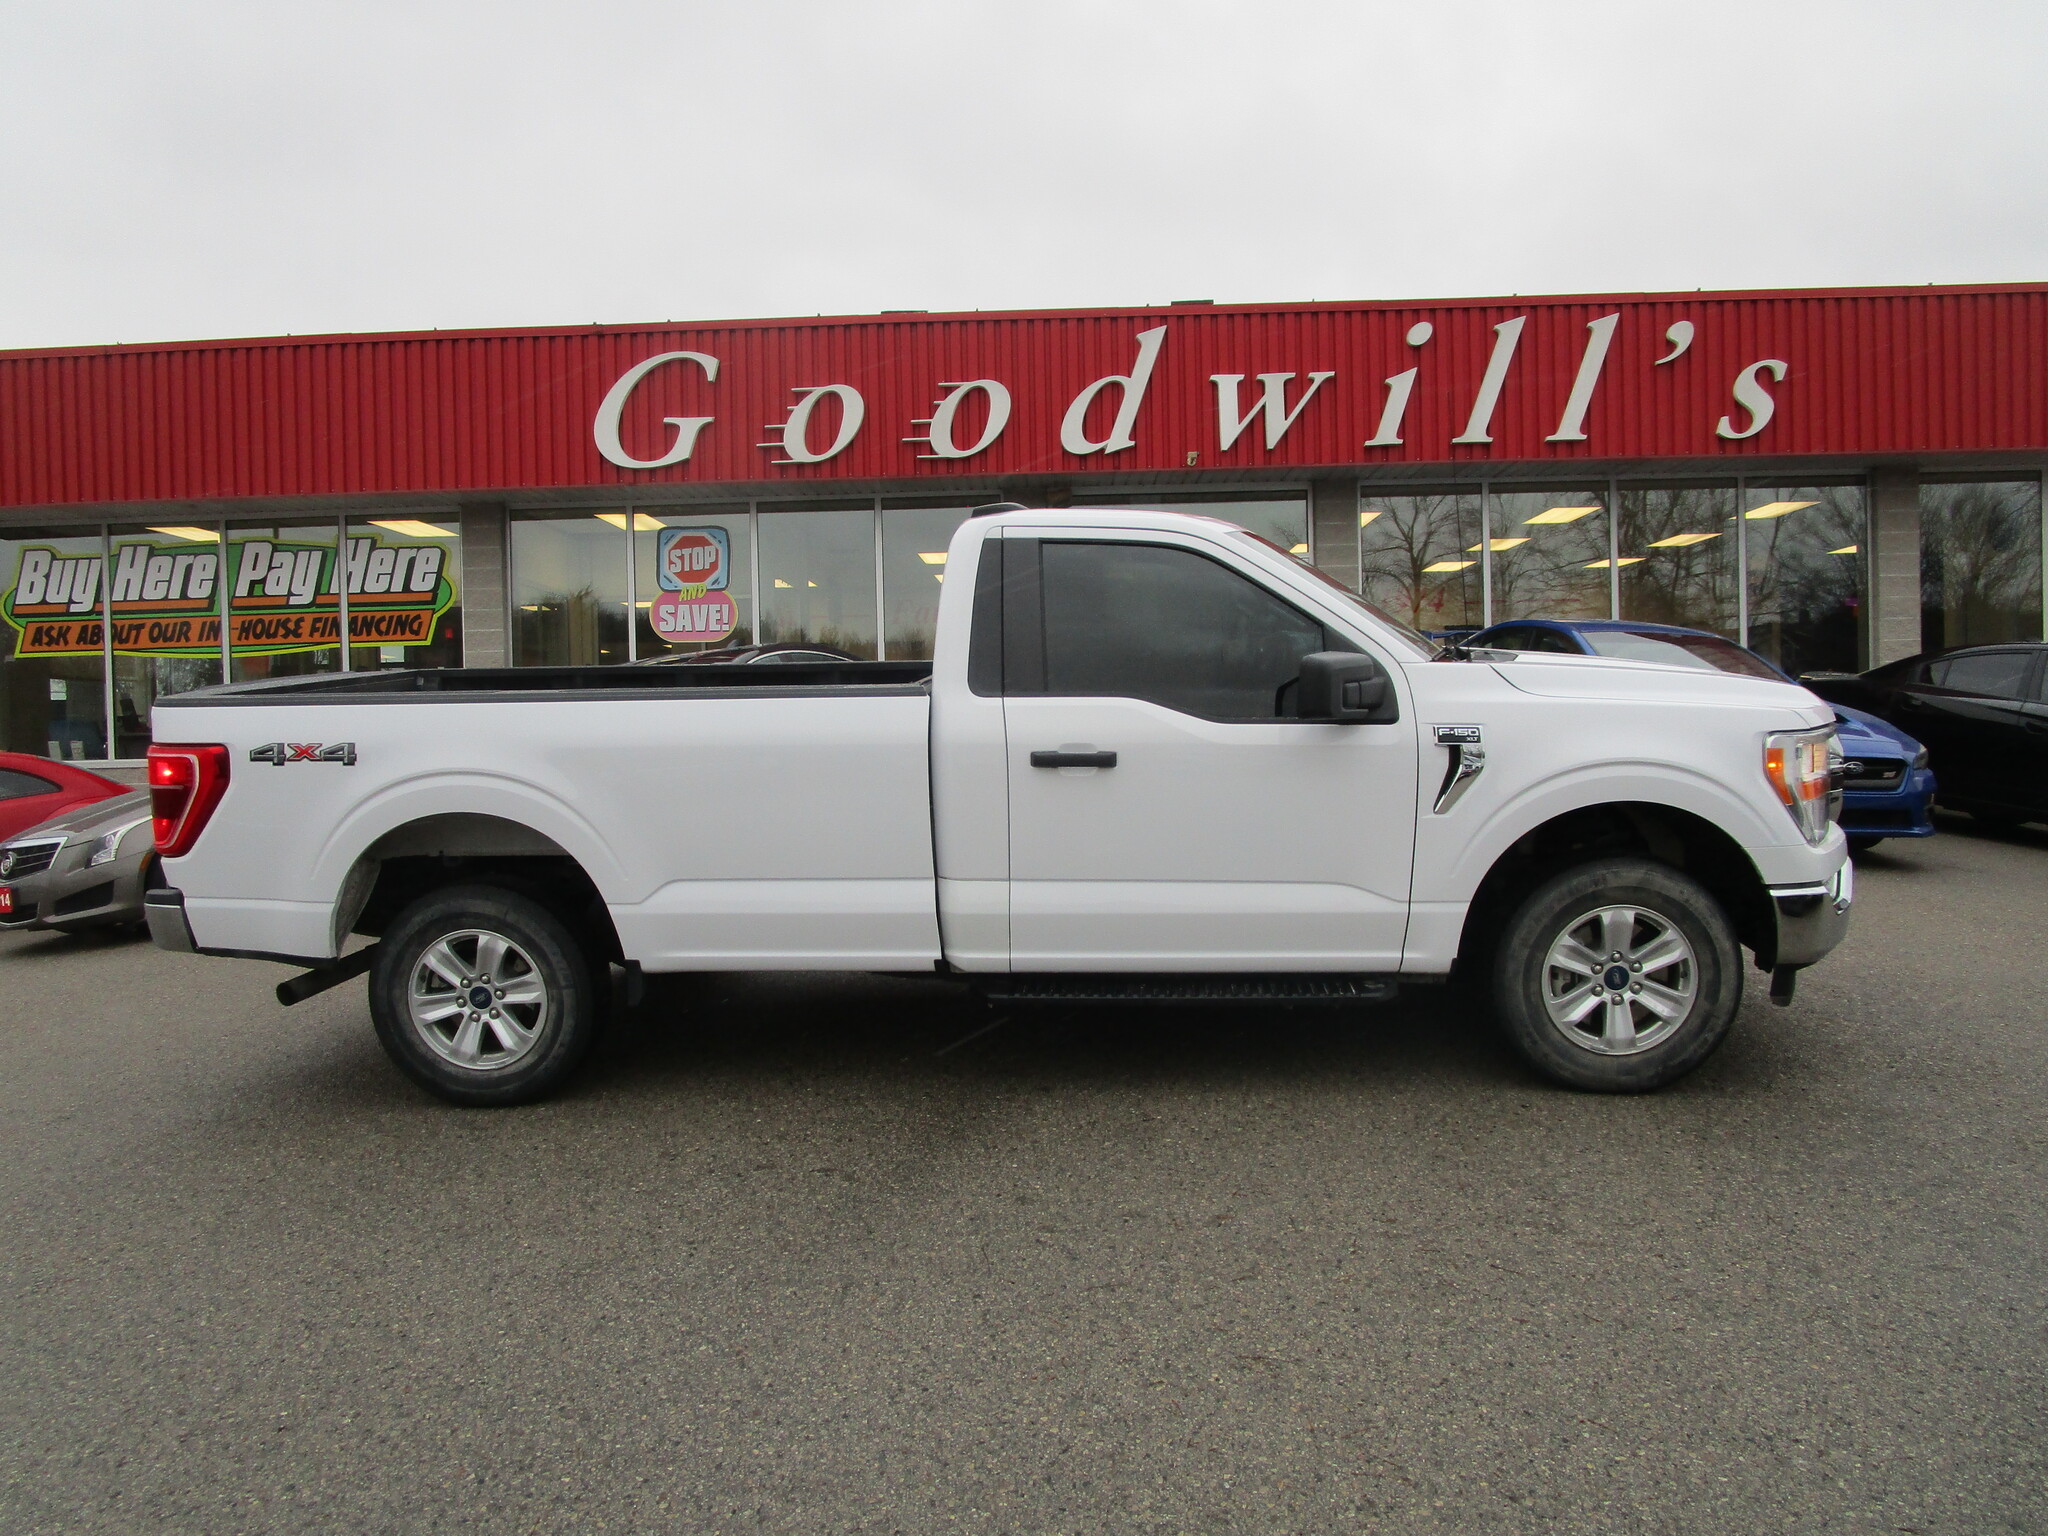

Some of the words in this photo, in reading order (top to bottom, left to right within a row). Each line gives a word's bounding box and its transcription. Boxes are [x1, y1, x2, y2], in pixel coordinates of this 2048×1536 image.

[593, 312, 1789, 469] Goodwill's
[669, 545, 716, 573] STOP
[15, 549, 102, 613] Buy
[111, 545, 218, 602] Here
[234, 541, 323, 606] Pay
[328, 538, 443, 594] Here
[678, 583, 707, 601] AND
[30, 625, 71, 647] ASK
[75, 622, 147, 646] ABOUT
[148, 620, 191, 643] OUR
[308, 613, 423, 639] FINANCING
[659, 603, 730, 632] SAVE!
[1438, 728, 1479, 736] F-150
